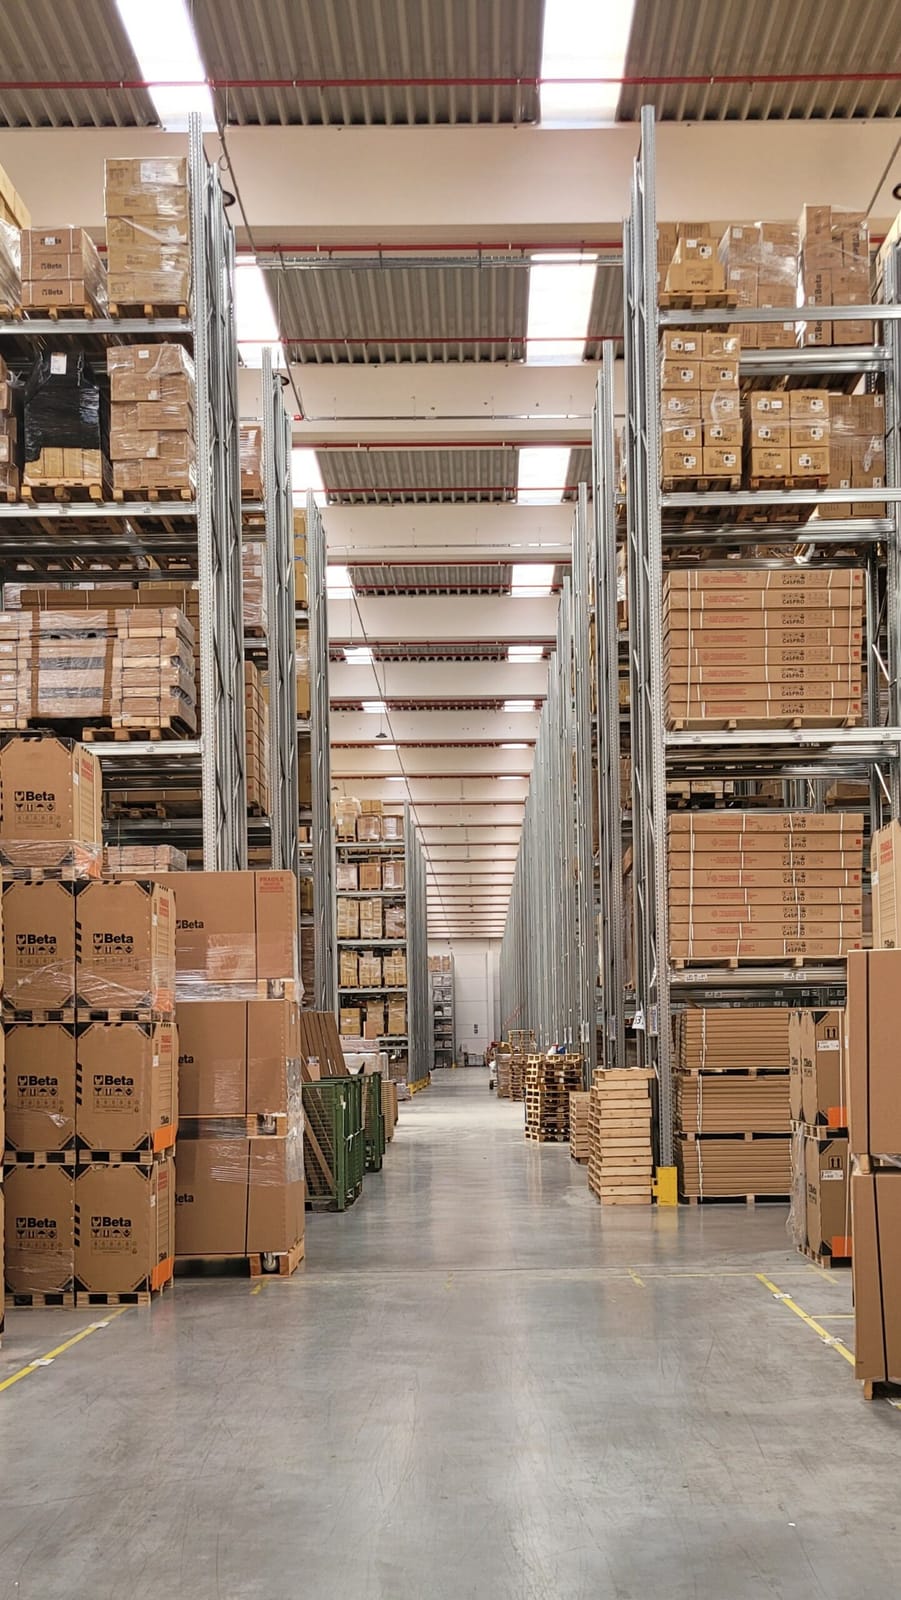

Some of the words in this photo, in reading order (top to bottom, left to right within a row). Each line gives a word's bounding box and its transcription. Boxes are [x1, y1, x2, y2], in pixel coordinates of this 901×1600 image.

[26, 792, 55, 801] Beta
[182, 920, 204, 928] Beta
[27, 935, 56, 944] Beta
[104, 934, 134, 944] Beta
[178, 1054, 194, 1064] eta
[29, 1076, 58, 1086] Beta
[105, 1076, 134, 1085] Beta
[28, 1218, 56, 1228] Beta
[102, 1217, 132, 1227] Beta
